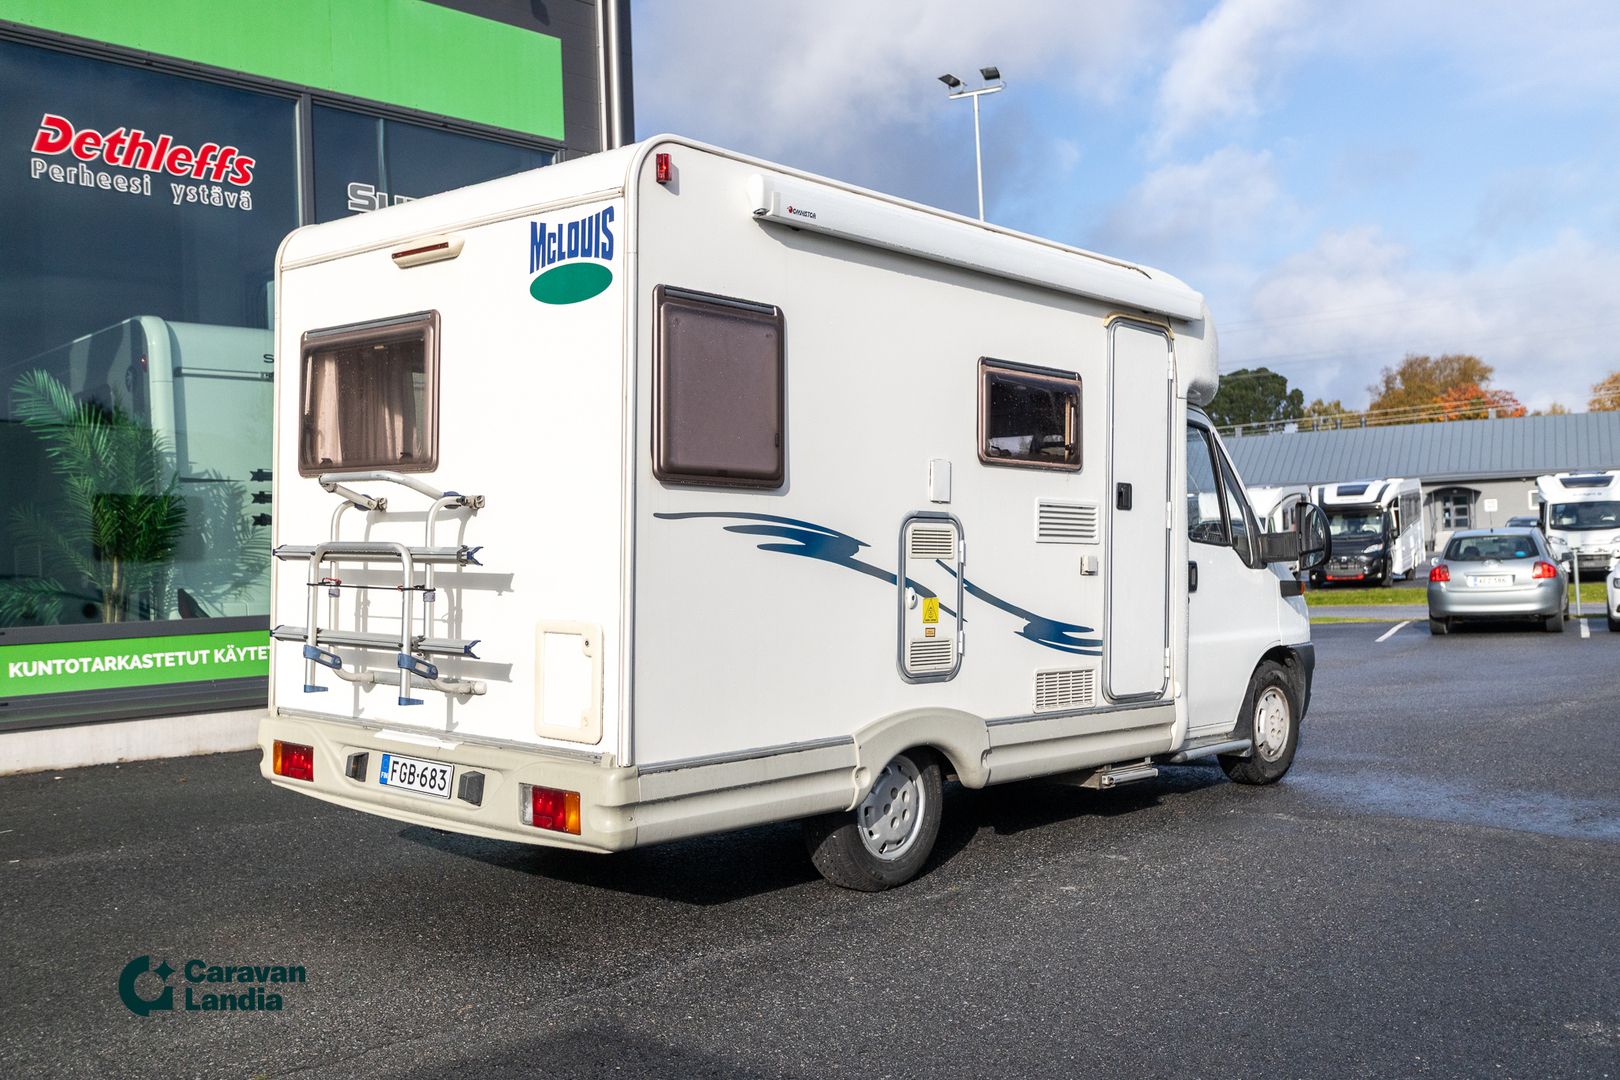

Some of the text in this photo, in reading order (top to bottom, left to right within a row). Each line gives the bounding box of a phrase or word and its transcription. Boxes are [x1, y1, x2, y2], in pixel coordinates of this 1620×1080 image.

[31, 113, 256, 186] Dethleffs
[30, 157, 252, 210] Perheesi ystävä
[8, 644, 271, 678] KUNTOTARKASTETUT KÄYTE
